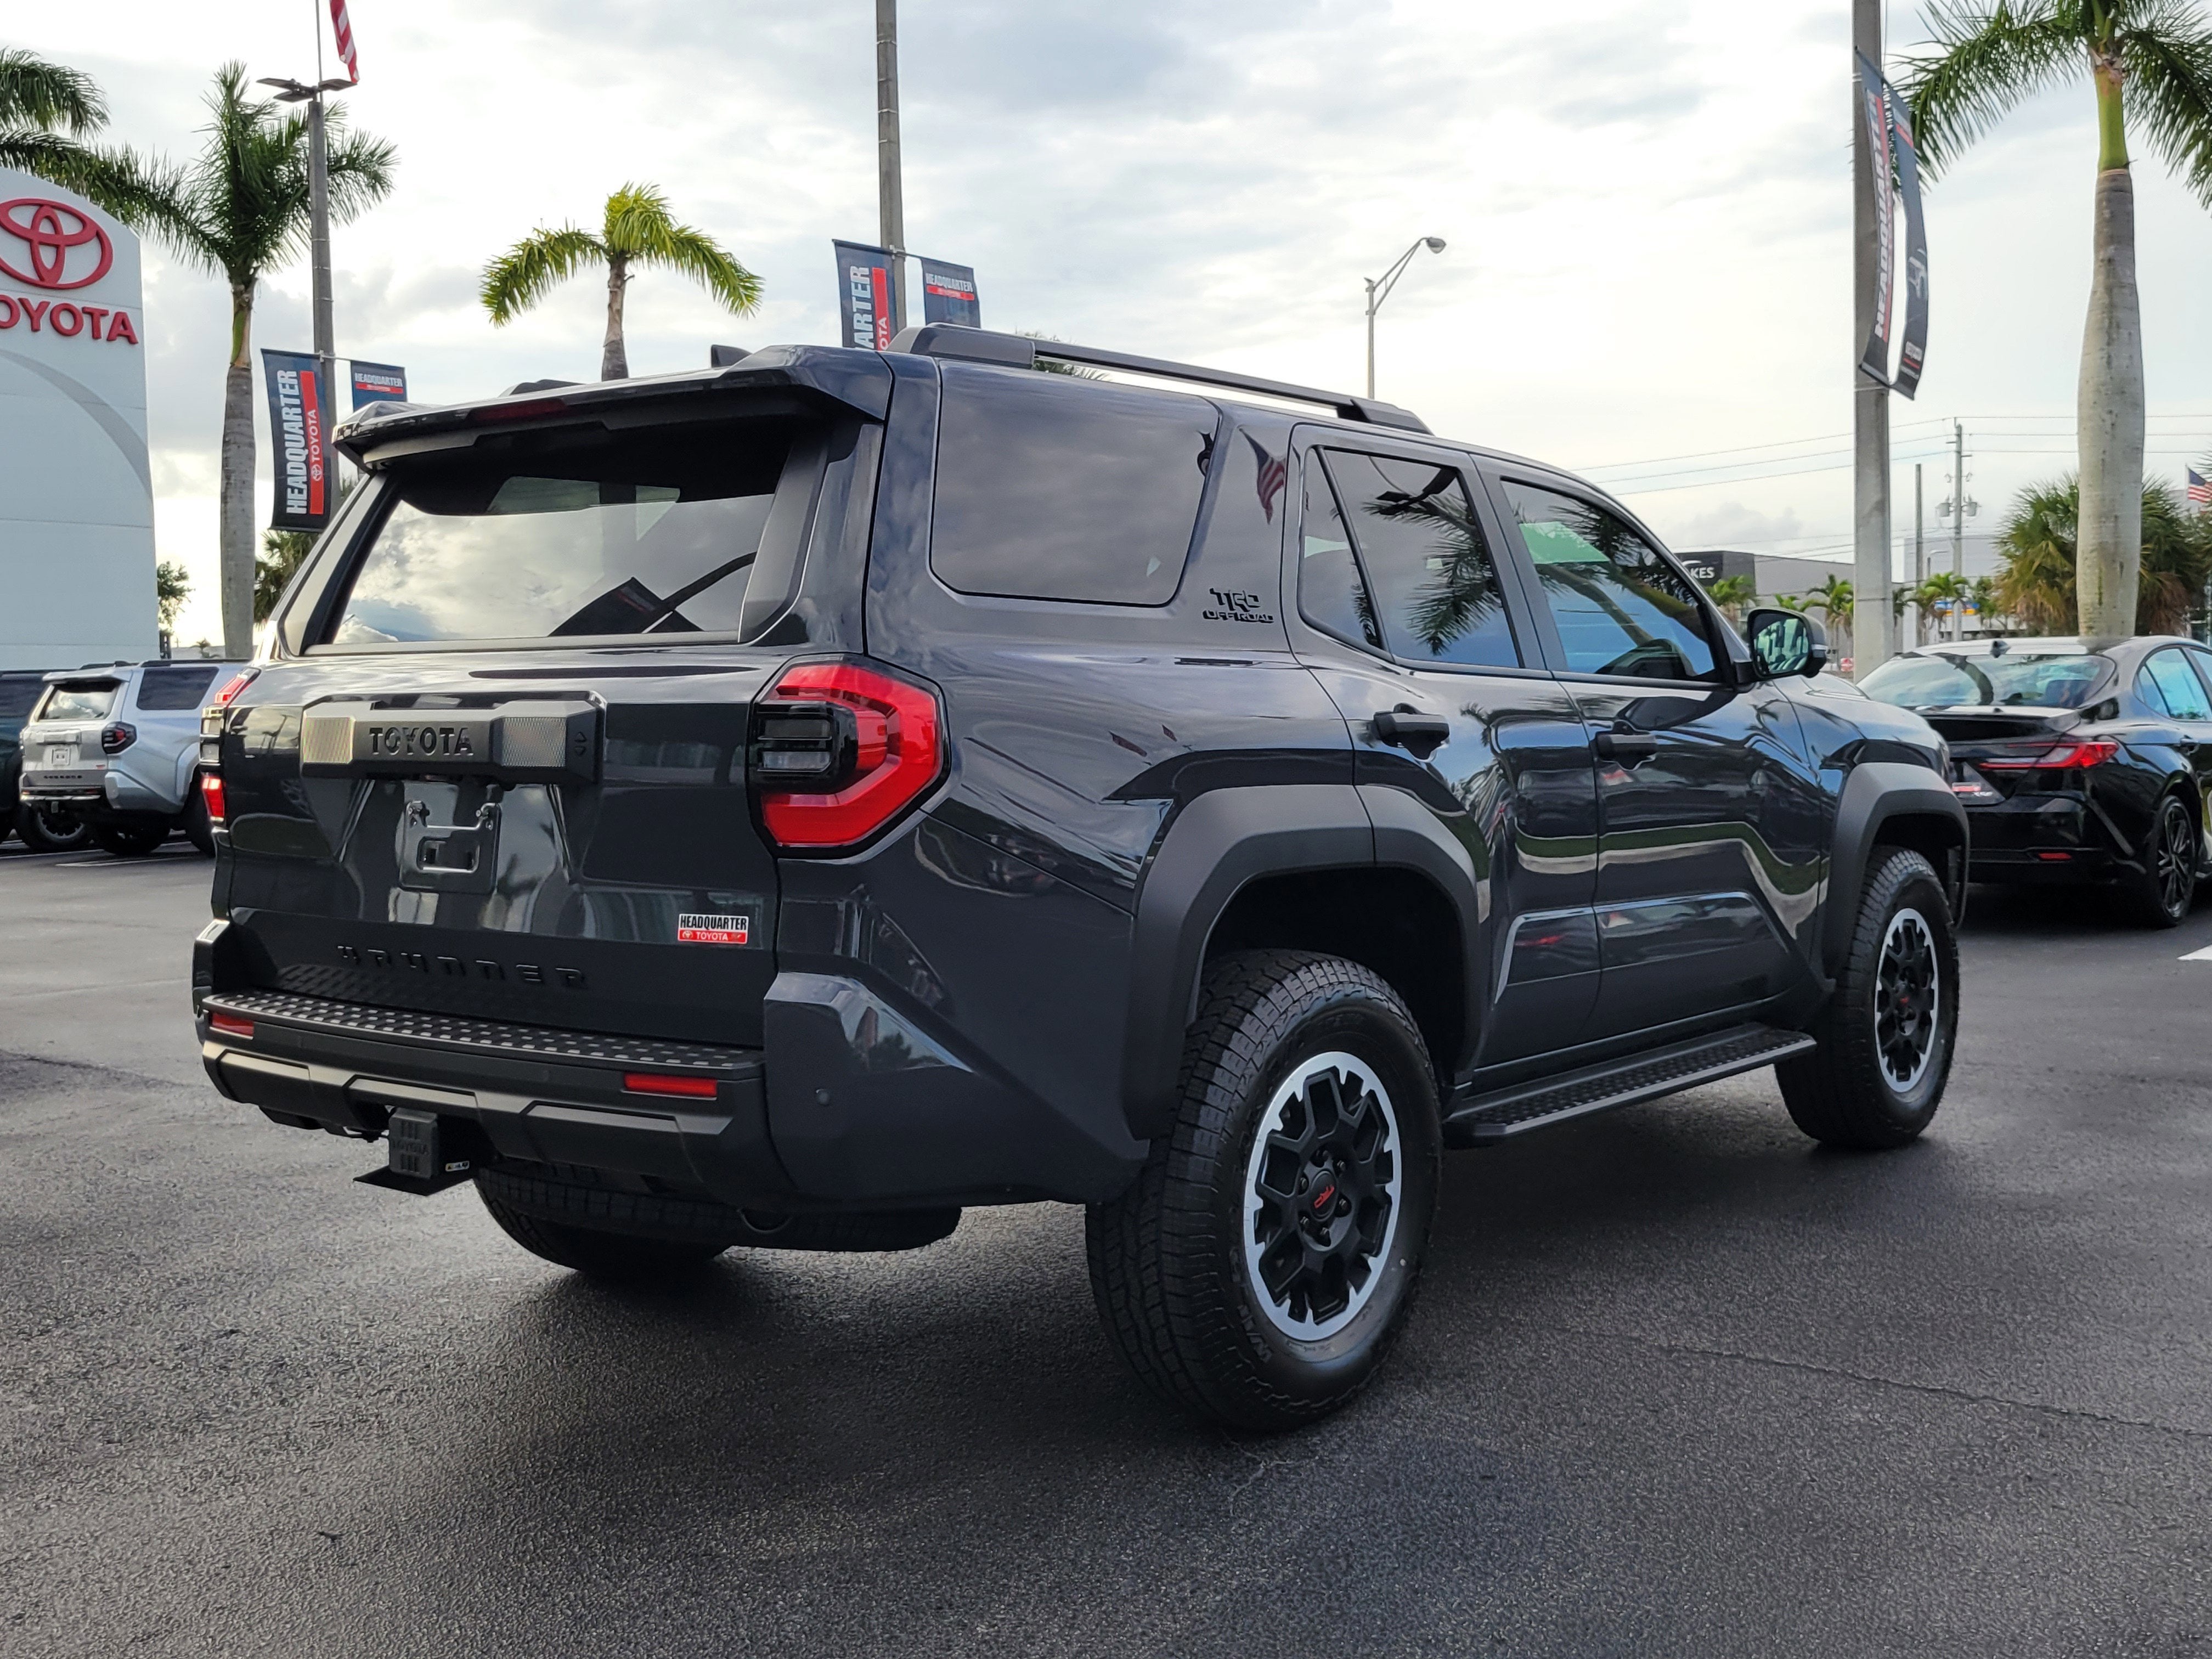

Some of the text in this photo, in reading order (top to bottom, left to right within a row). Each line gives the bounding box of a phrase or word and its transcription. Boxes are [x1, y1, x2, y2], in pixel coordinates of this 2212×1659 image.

[277, 370, 307, 515] HEADQUARTER
[307, 409, 320, 463] TOYOTA
[1209, 588, 1261, 612] TRD
[369, 727, 474, 756] TOYOTA
[680, 915, 747, 930] HEADQUARTER
[696, 931, 729, 941] TOYOTA
